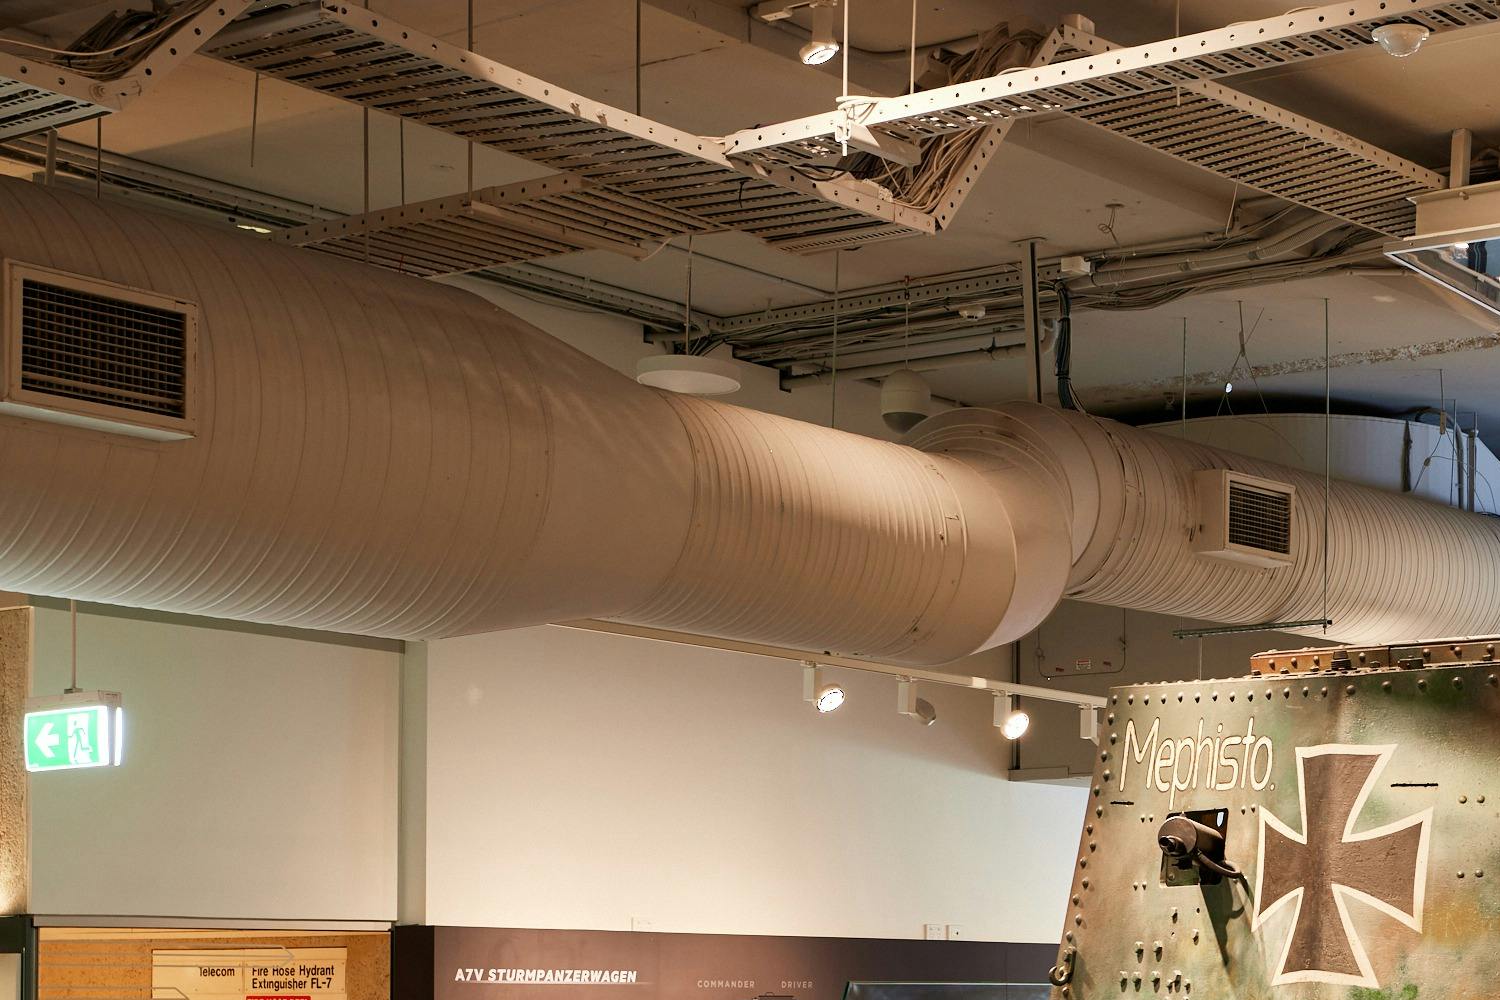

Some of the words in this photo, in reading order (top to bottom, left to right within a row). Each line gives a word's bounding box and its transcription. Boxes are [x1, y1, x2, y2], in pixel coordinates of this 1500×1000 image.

[252, 966, 268, 977] Fire
[272, 966, 295, 977] Hose
[299, 965, 335, 978] Hydrant
[455, 968, 483, 982] A7V
[488, 968, 637, 983] STURMPANZERWAGEN
[252, 977, 307, 991] Extinguisher
[311, 977, 332, 989] FL-7
[697, 980, 755, 989] COMMANDER
[781, 980, 813, 989] DRIVER
